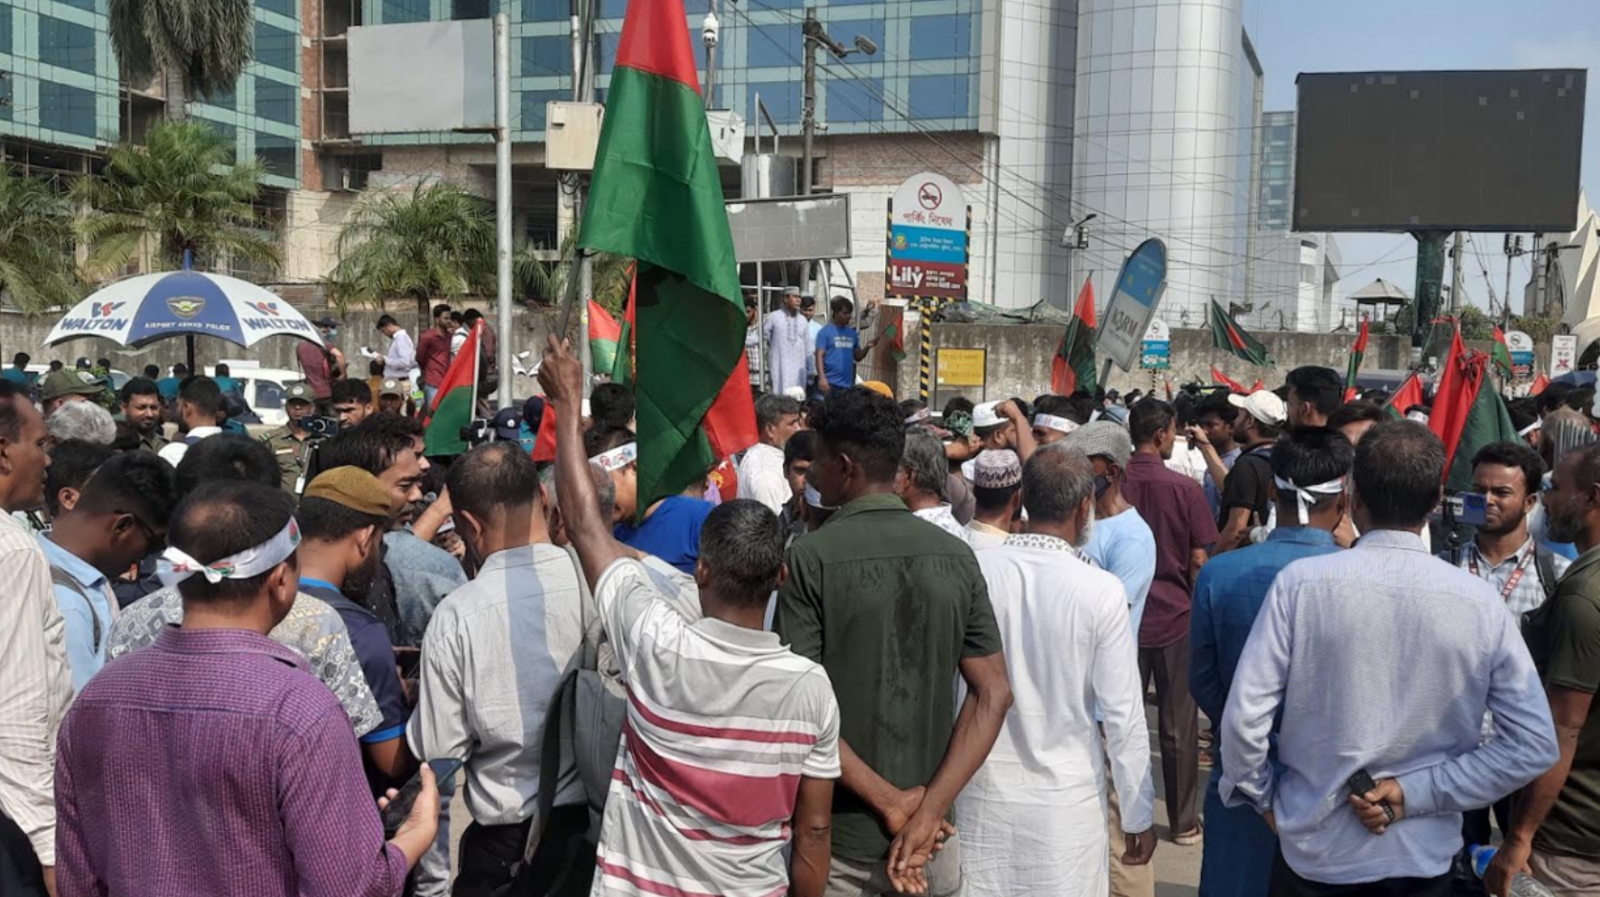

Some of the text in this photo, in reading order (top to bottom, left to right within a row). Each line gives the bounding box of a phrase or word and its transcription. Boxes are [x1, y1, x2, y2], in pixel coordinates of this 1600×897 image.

[892, 265, 924, 289] Lily
[60, 317, 129, 331] WALTON
[144, 321, 176, 329] AIRPORT
[205, 322, 231, 331] POLICE
[241, 317, 312, 333] WALTON
